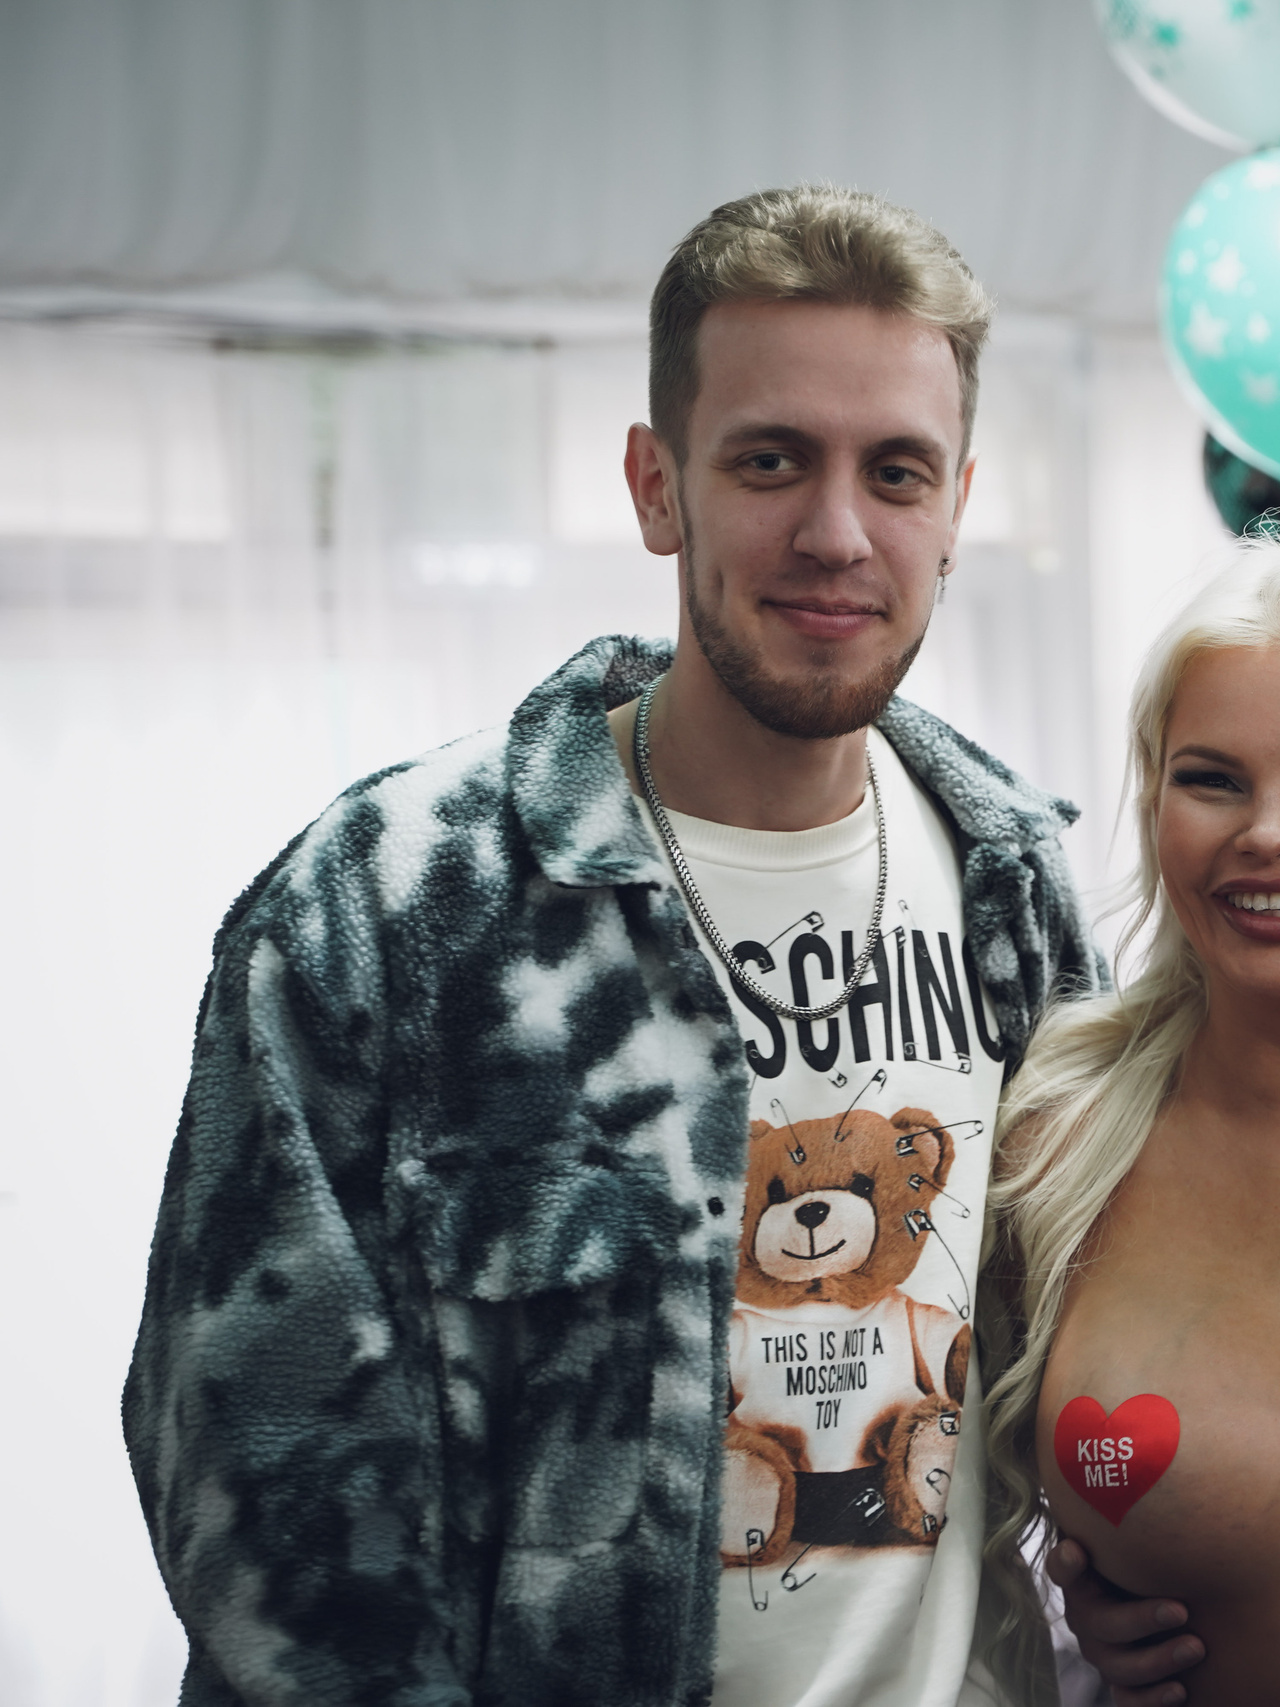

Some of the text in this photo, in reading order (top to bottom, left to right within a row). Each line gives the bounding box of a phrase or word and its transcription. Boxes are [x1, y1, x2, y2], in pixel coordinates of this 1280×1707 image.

[761, 1327, 884, 1363] THIS IS NOT A
[786, 1361, 867, 1396] MOSCHINO
[816, 1399, 842, 1430] TOY
[1077, 1437, 1134, 1462] KISS
[1084, 1463, 1129, 1487] ME!
